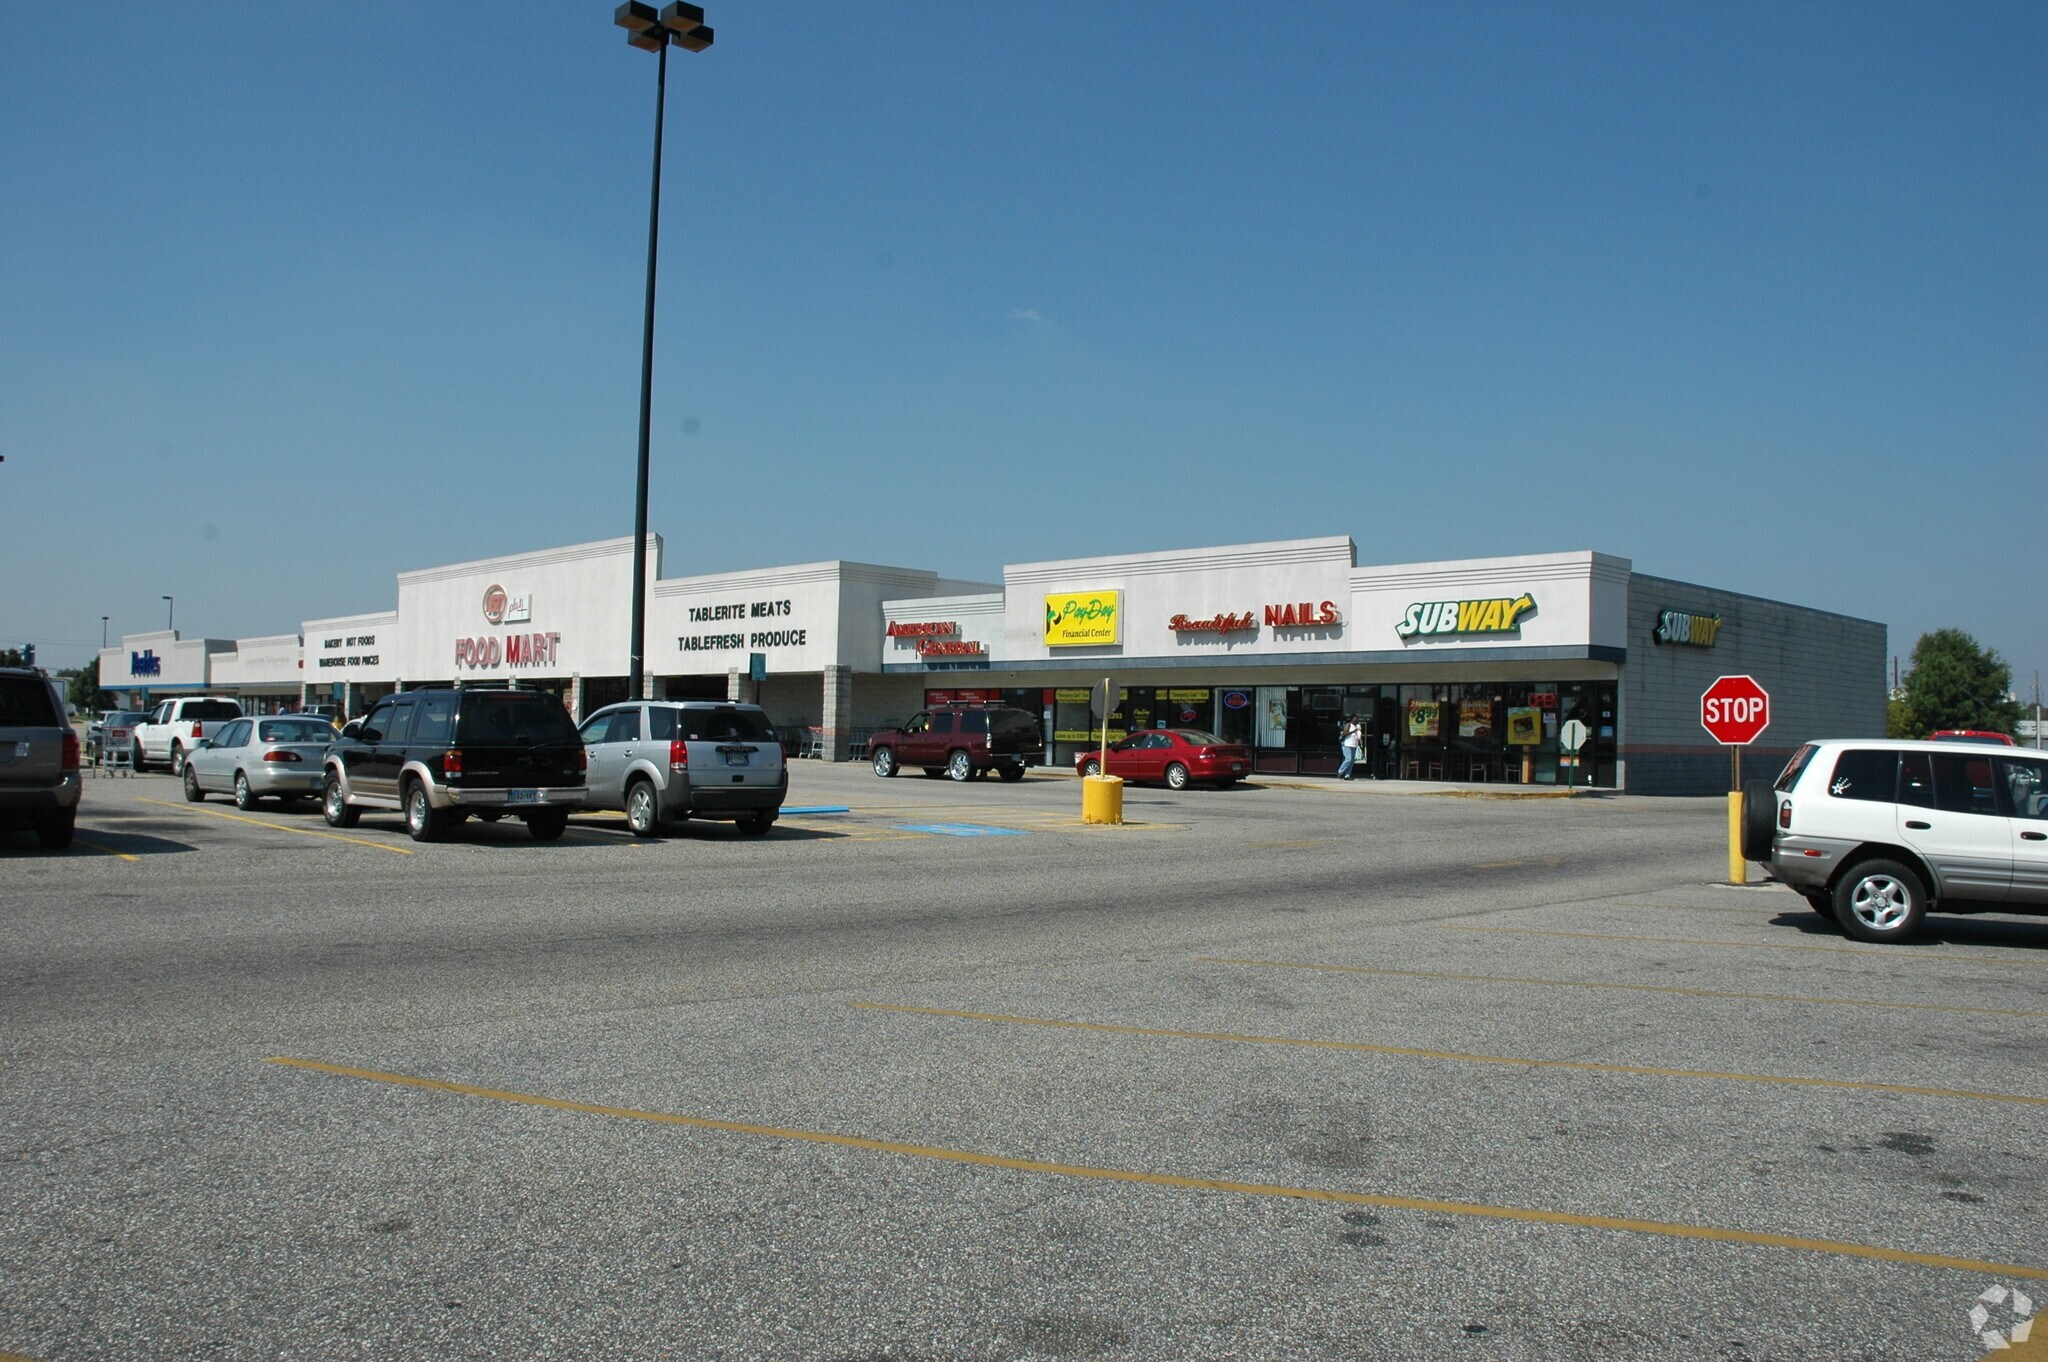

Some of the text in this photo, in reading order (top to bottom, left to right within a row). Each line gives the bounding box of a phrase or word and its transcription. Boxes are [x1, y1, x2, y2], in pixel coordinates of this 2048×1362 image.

[689, 599, 791, 622] TABLERITE MEATS
[1063, 599, 1115, 625] PayDay
[1168, 600, 1338, 636] Beautiful NAILS
[1396, 595, 1533, 636] SUBWAY
[346, 636, 356, 647] HOT
[357, 635, 375, 646] FOODS
[678, 629, 807, 651] TABLEFRESH PRODUCE
[1062, 629, 1111, 638] Financial Center
[1659, 611, 1721, 645] SUBWAY
[347, 656, 361, 666] FOOD
[455, 632, 559, 667] FOOD MART
[1706, 697, 1764, 723] STOP
